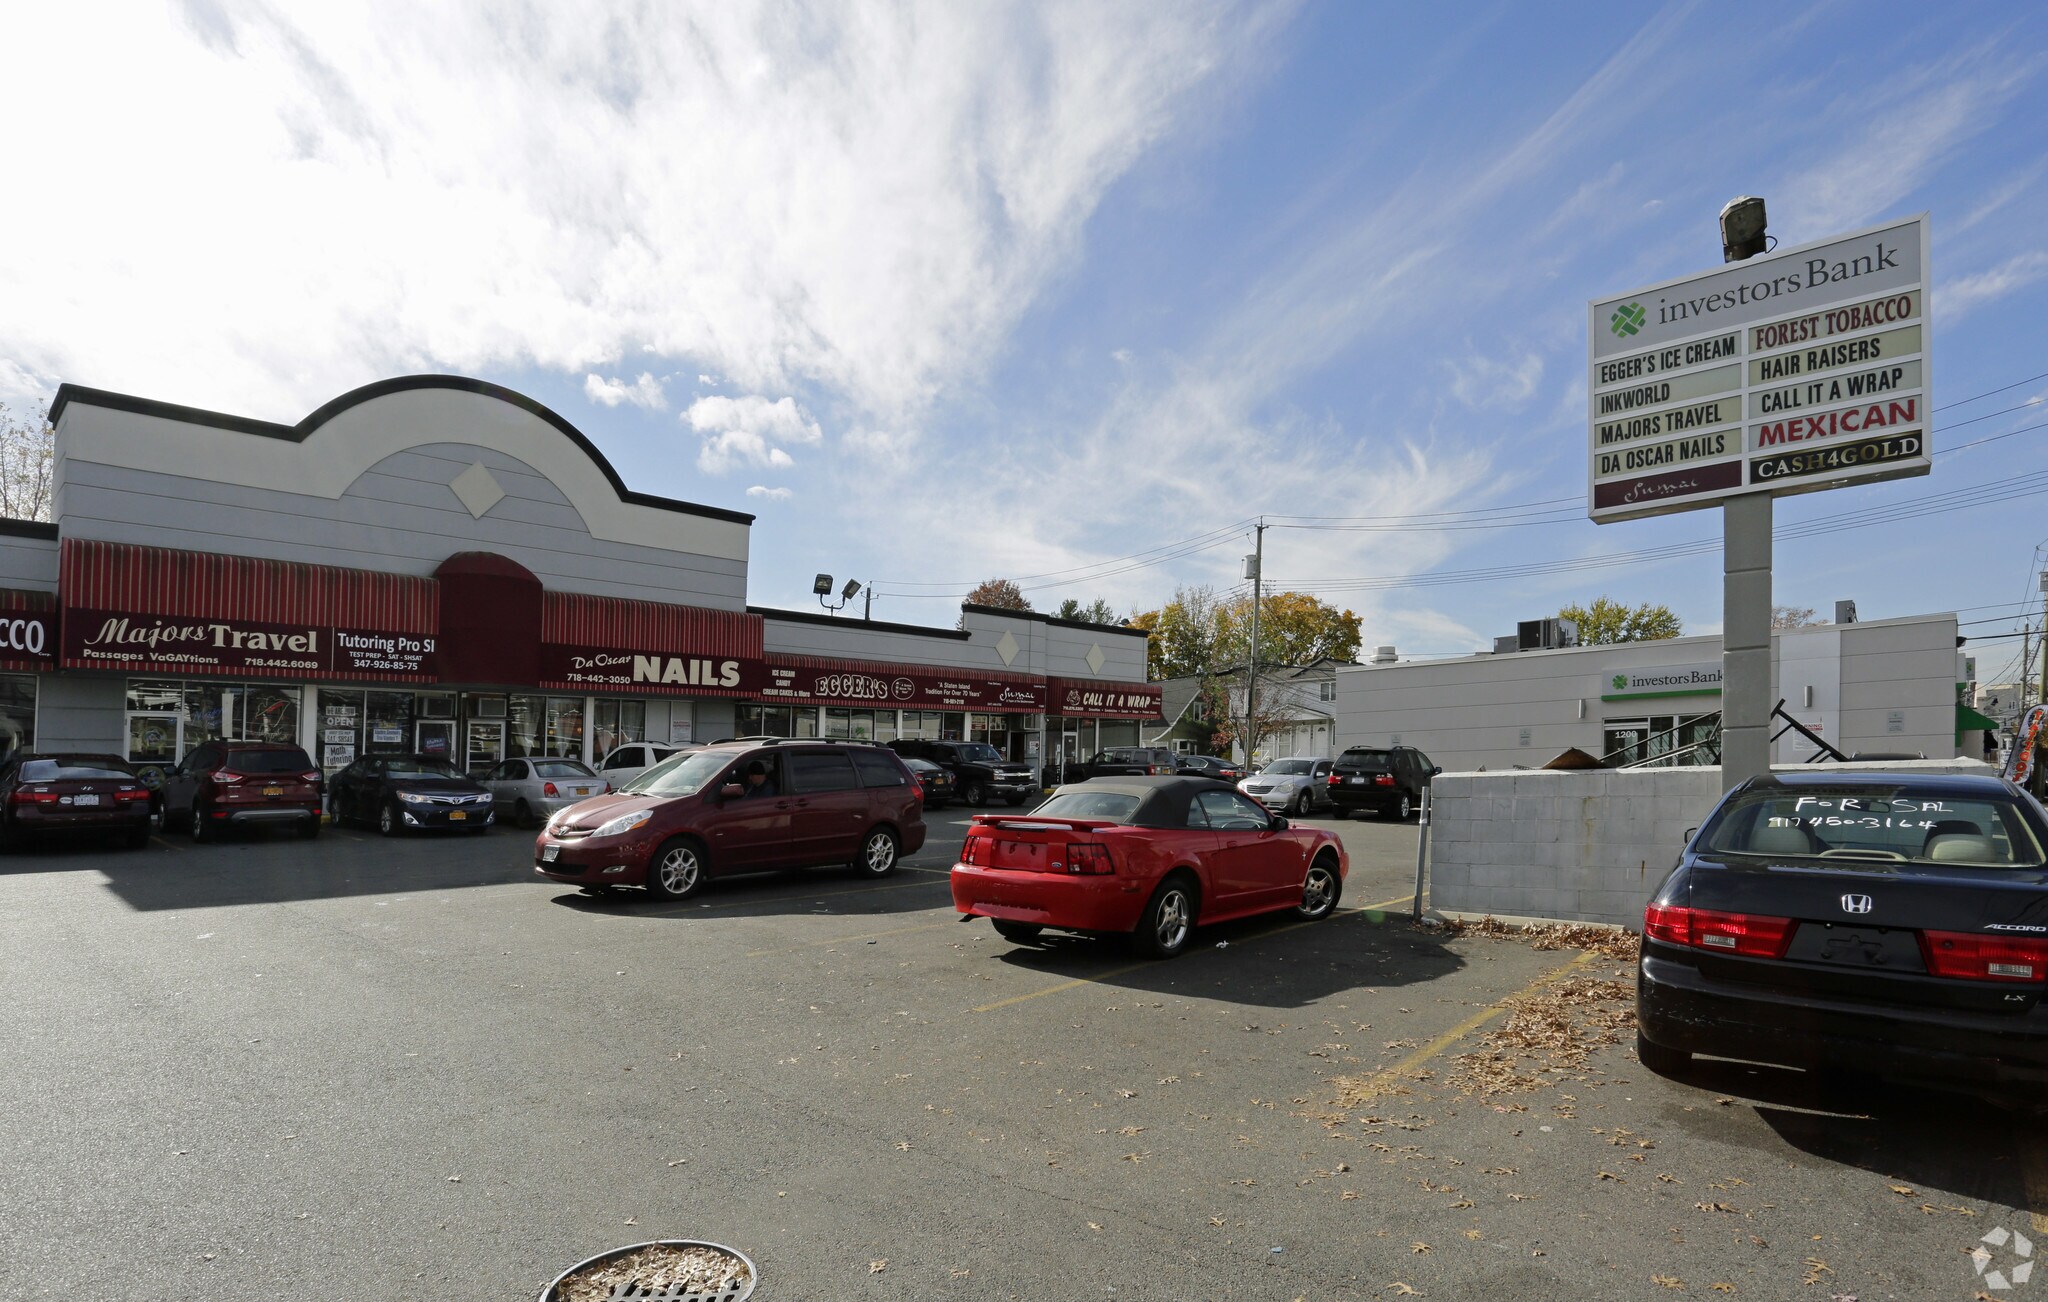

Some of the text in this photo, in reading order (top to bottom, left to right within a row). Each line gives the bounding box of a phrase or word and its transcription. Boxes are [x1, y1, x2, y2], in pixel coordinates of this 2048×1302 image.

[1756, 296, 1912, 350] FOREST TOBACCO
[1601, 336, 1735, 383] EGGER'S ICE CREAM
[1761, 338, 1880, 380] HAIR RAISERS
[1601, 383, 1670, 414] INKWORLD
[1762, 368, 1903, 413] CALL IT A WRAP
[1601, 404, 1722, 444] MAJORS TRAVEL
[1758, 399, 1915, 448] MEXICAN
[1601, 435, 1725, 474] DA OSCAR NAILS
[1758, 438, 1919, 478] CASH4GOLD
[84, 618, 317, 653] Majors Travel
[338, 633, 435, 653] Tutoring Pro SI
[83, 649, 218, 665] Passages VaGAYtions
[245, 657, 318, 669] 718.442.6069
[353, 659, 418, 670] 347-926-85-75
[571, 653, 632, 669] Da Oscar
[567, 673, 631, 684] 718-442-3050
[633, 655, 740, 687] NAILS
[815, 674, 888, 699] EGGER'S
[1083, 692, 1103, 706] CALL
[1106, 694, 1115, 706] IT
[1118, 694, 1124, 707] A
[1127, 695, 1151, 708] WRAP
[327, 717, 354, 726] OPEN
[1615, 730, 1637, 738] 1200
[331, 746, 346, 756] Math
[1984, 924, 2047, 932] ACCORD
